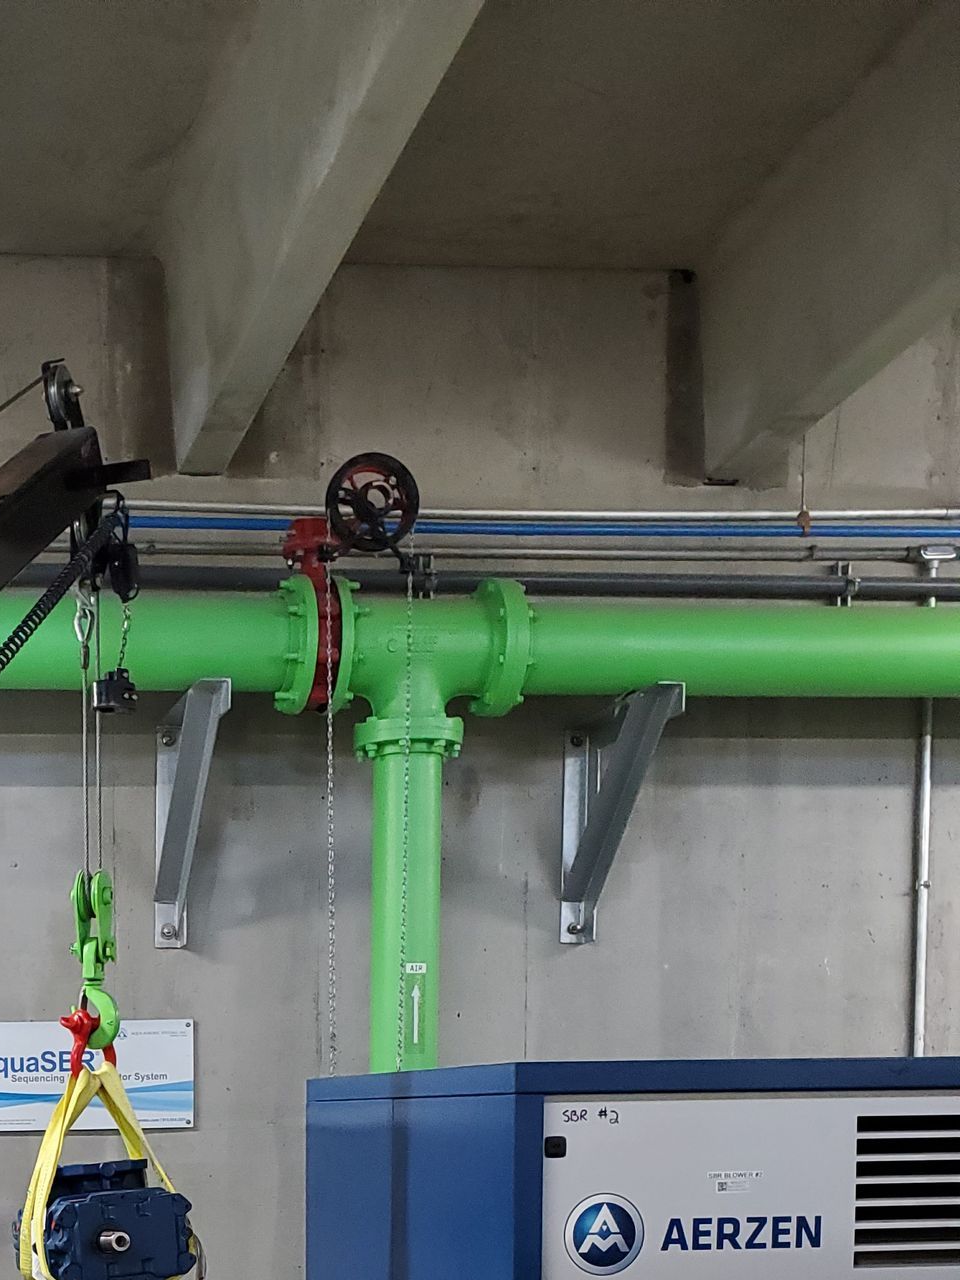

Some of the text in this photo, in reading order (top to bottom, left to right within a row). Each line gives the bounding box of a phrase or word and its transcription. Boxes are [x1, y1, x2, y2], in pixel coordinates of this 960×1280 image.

[10, 1073, 65, 1084] Sequencing
[134, 1071, 168, 1082] System
[561, 1106, 620, 1125] SBR #2
[660, 1215, 822, 1251] AERZEN
